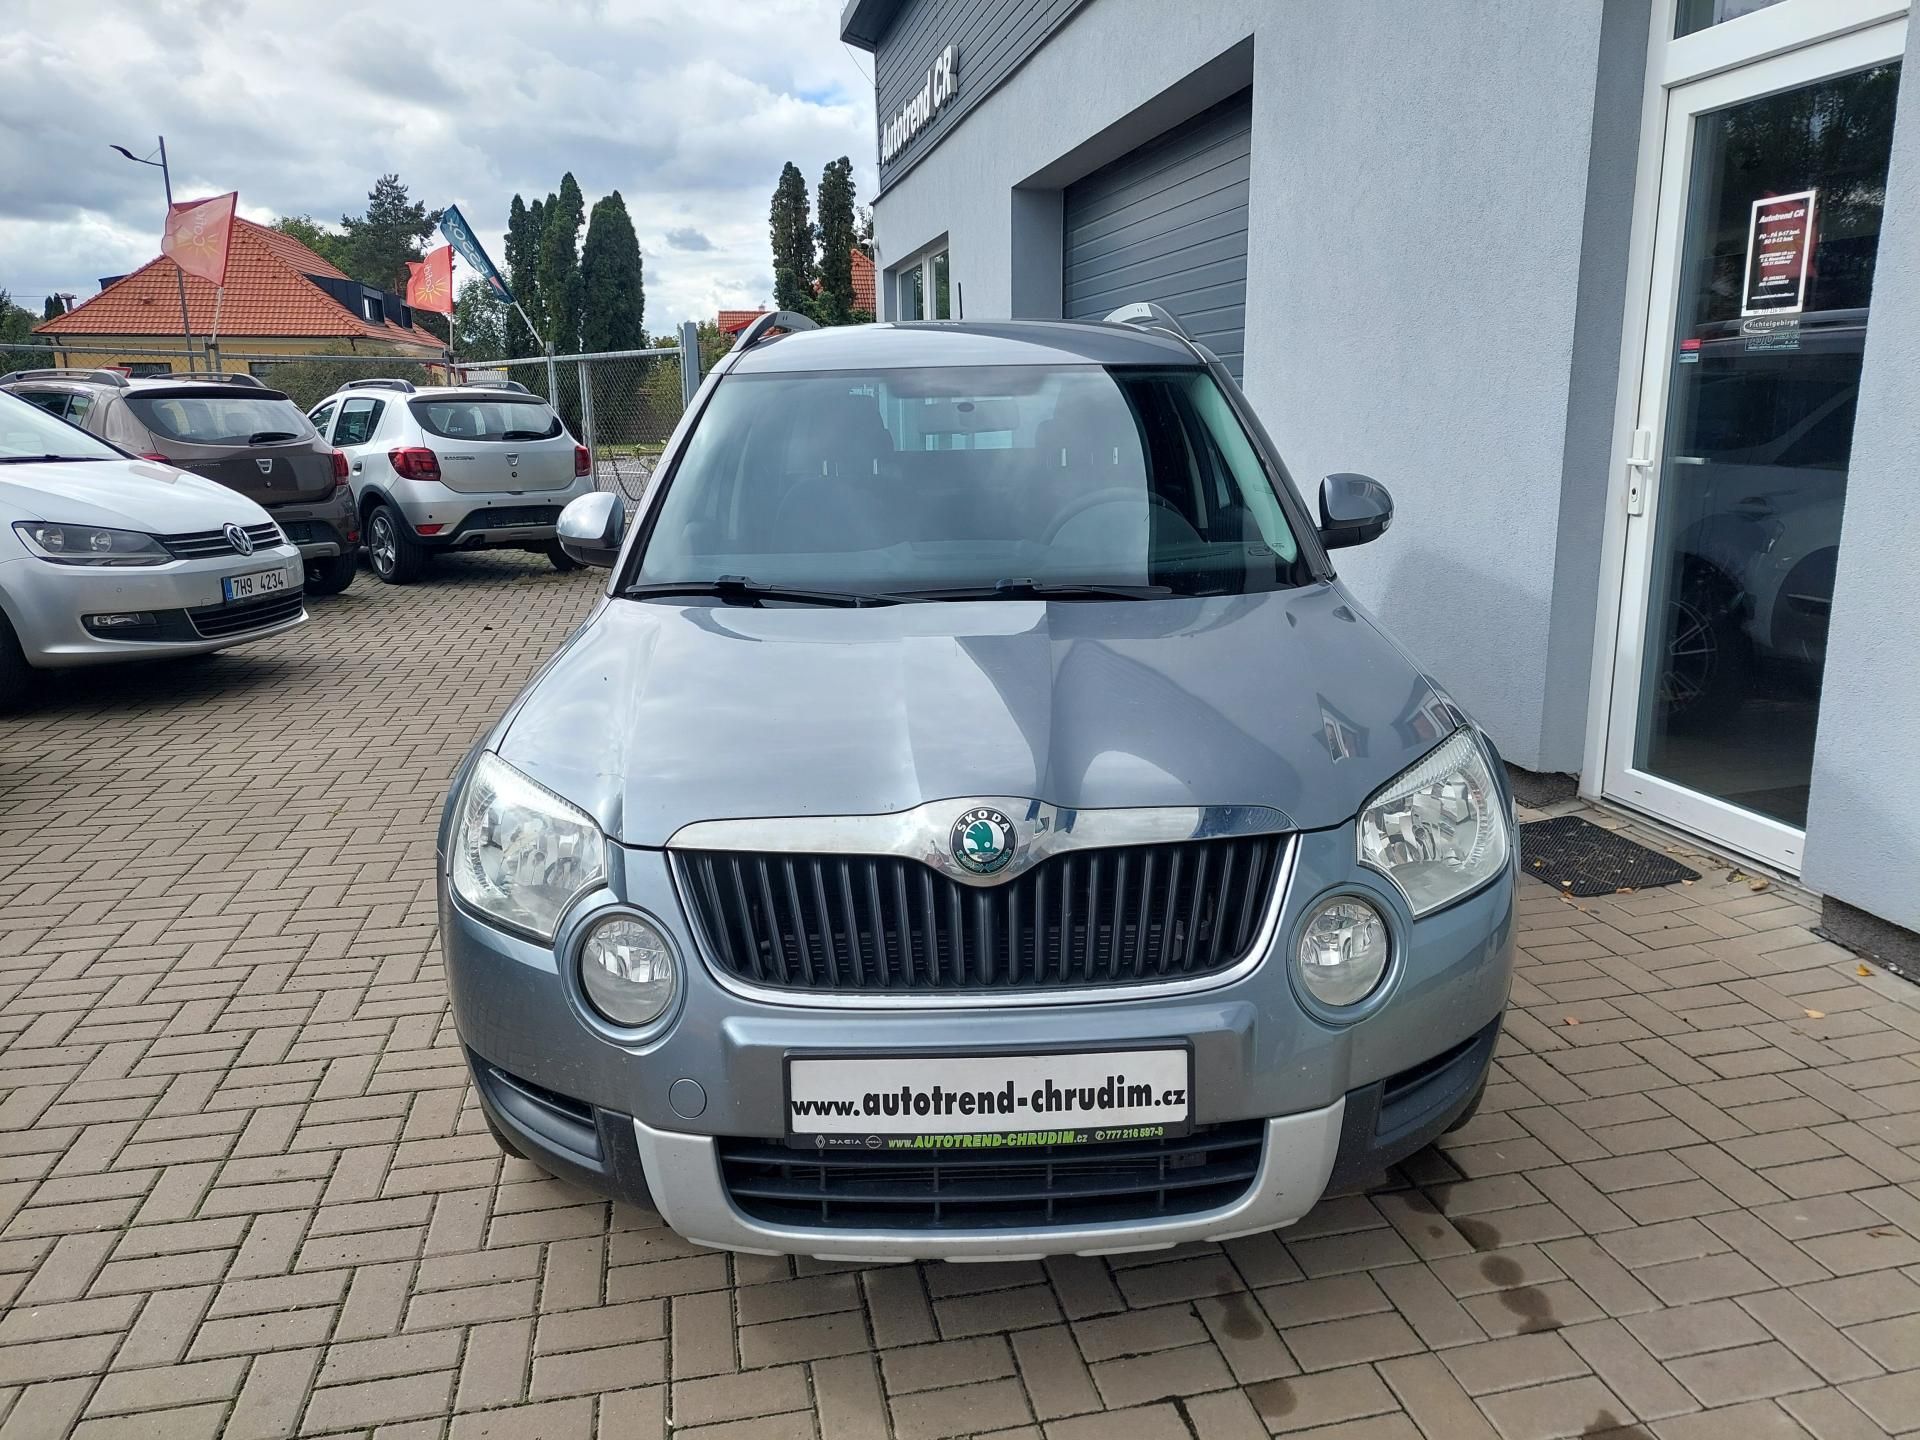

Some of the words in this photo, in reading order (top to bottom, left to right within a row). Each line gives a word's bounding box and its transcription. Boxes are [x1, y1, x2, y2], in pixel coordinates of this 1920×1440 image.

[881, 69, 932, 165] Autotrend
[1759, 211, 1794, 223] Autotrend
[233, 577, 253, 597] 7H9
[260, 571, 284, 591] 4234
[791, 1075, 1186, 1117] www.autotrend-chrudim.cz
[888, 1131, 1088, 1148] www.AUTOTREND-CHRUDIM.cz
[1106, 1130, 1123, 1140] 777
[1123, 1128, 1139, 1139] 216
